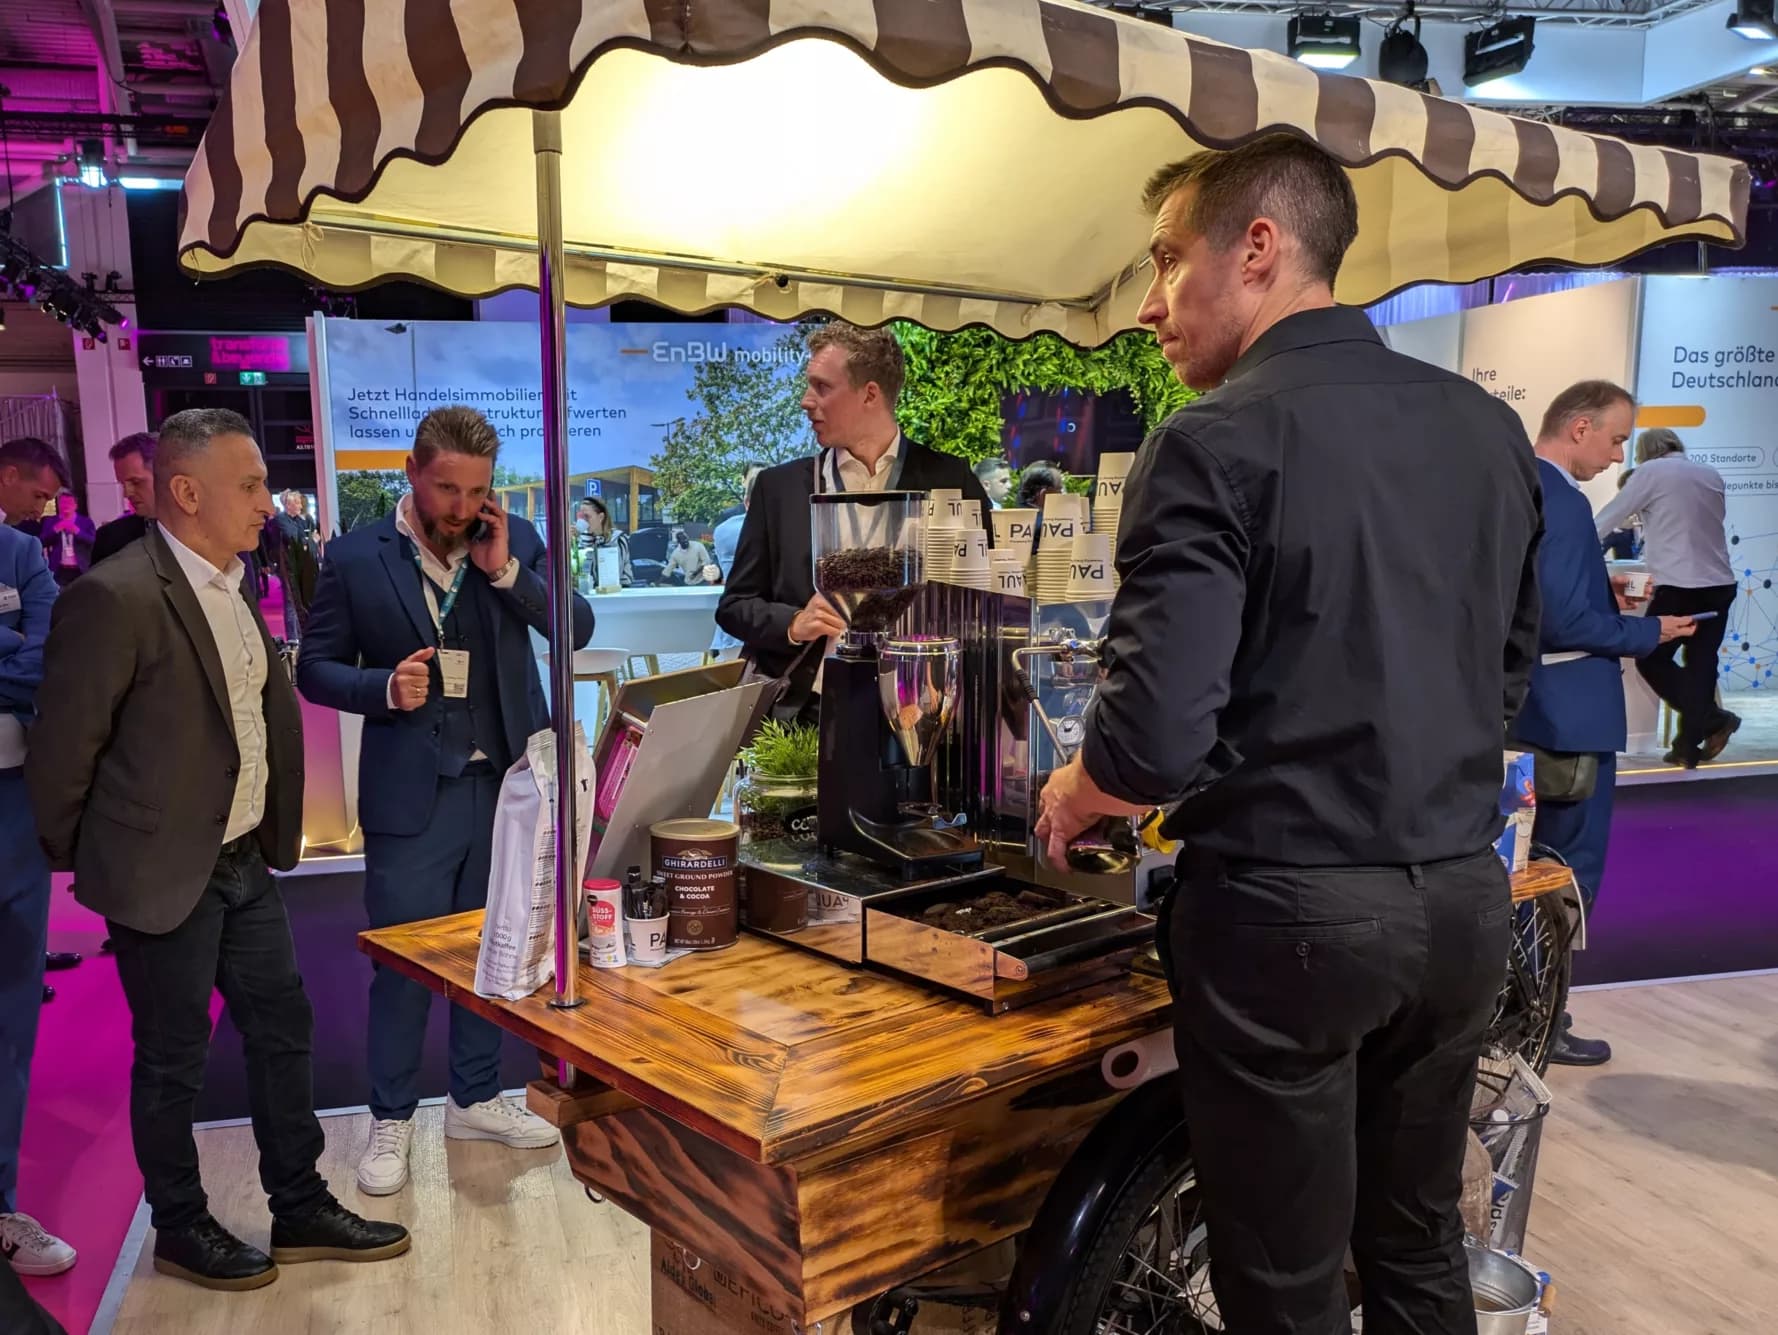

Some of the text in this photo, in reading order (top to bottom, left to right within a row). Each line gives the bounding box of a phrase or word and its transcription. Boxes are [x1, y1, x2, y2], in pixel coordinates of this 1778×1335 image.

[652, 341, 727, 363] EnBW
[1673, 345, 1775, 368] Das größte
[1472, 367, 1497, 382] Ihre
[348, 388, 389, 401] Jetzt
[1490, 385, 1526, 401] teile:
[567, 405, 627, 419] fwerten
[350, 425, 400, 438] lassen
[521, 426, 601, 440] proeren
[1711, 452, 1757, 464] Standorte
[1724, 480, 1763, 491] epunkte
[1010, 523, 1033, 538] PA
[1042, 522, 1074, 538] PAU
[1070, 564, 1104, 580] PAU
[664, 858, 725, 869] GHIRARDELLI
[674, 872, 707, 880] GROUND
[650, 932, 666, 947] PA
